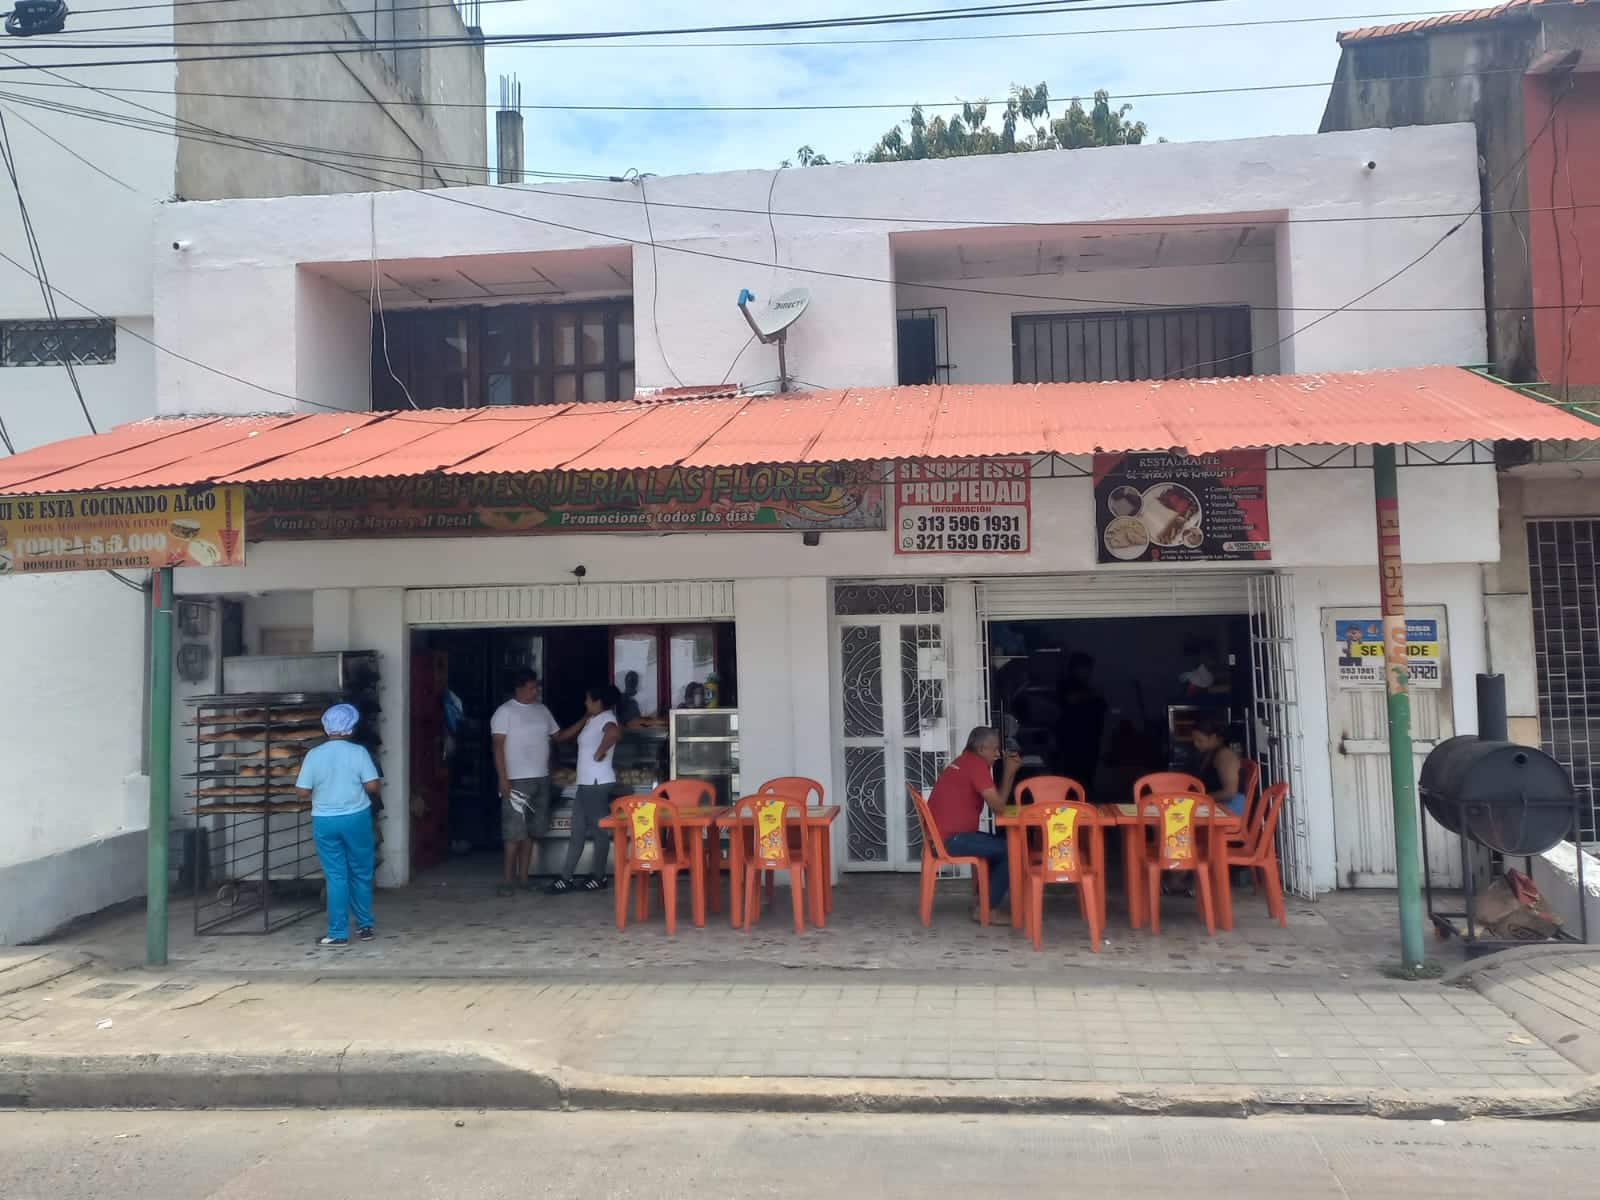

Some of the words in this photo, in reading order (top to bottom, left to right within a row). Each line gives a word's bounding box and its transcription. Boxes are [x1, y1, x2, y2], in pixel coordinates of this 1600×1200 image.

[643, 467, 702, 503] LAS
[708, 464, 832, 502] FLORES
[902, 480, 1026, 503] PROPIEDAD
[17, 501, 34, 520] SE
[40, 499, 74, 520] ESTA
[80, 494, 168, 516] COCINANDO
[173, 492, 216, 513] ALGO
[560, 511, 652, 525] Promociones
[656, 511, 696, 523] todos
[700, 510, 721, 522] los
[918, 515, 945, 532] 313
[949, 515, 980, 531] 596
[983, 515, 1020, 531] 1931
[916, 534, 943, 550] 321
[947, 534, 978, 549] 539
[982, 533, 1021, 549] 6736
[1360, 645, 1378, 656] SE
